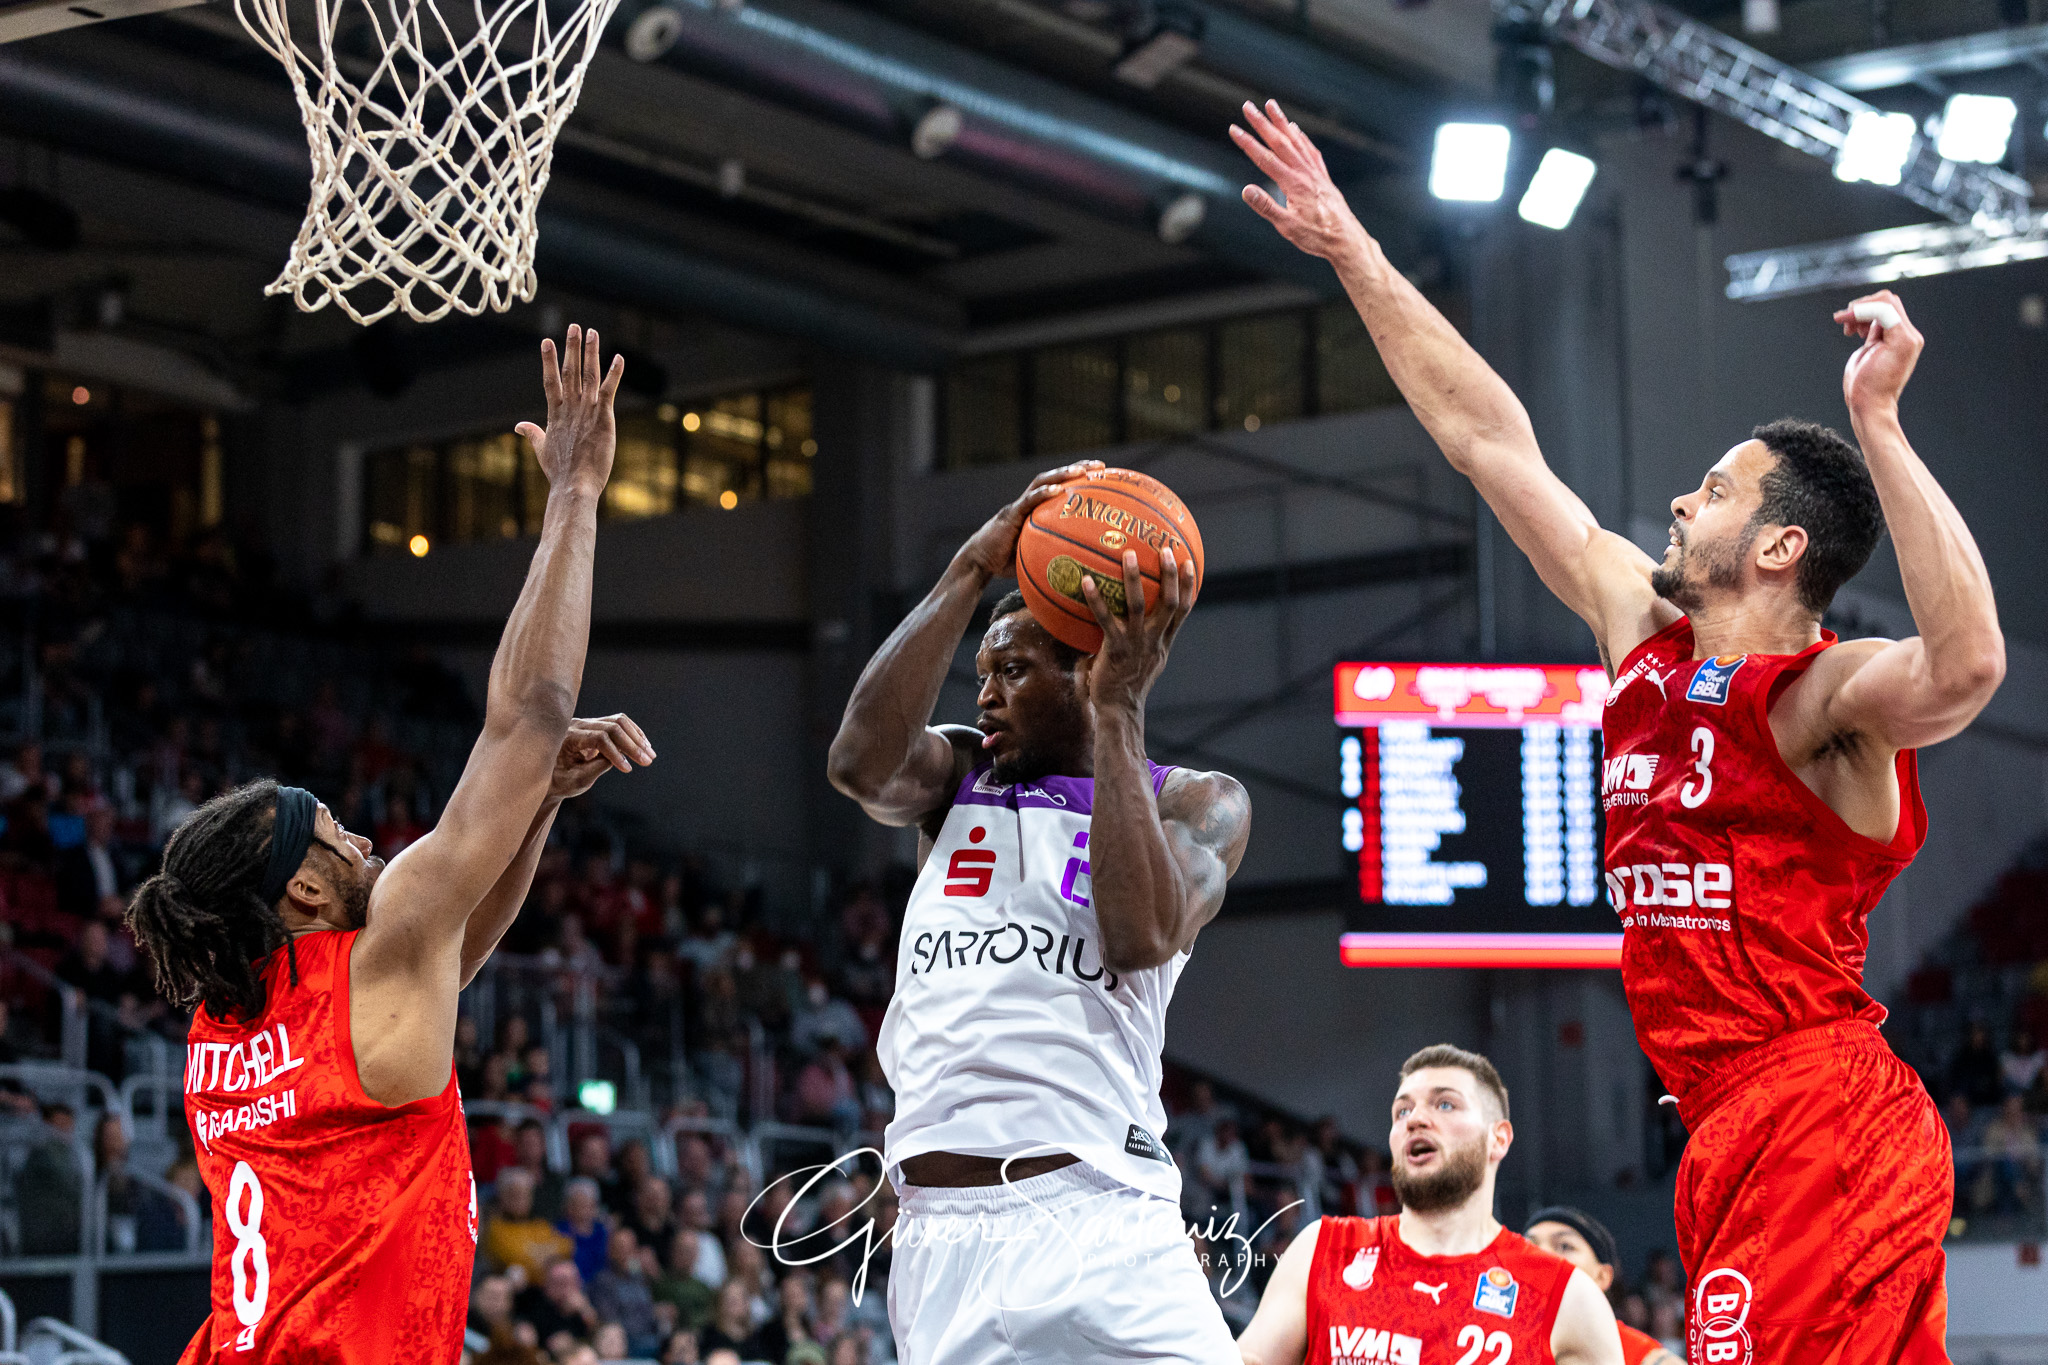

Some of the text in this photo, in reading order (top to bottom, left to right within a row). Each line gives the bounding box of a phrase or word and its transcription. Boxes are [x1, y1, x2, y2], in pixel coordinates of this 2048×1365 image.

[1060, 494, 1180, 552] SPALDING
[1691, 680, 1721, 698] BBL
[1680, 727, 1715, 809] 3
[911, 922, 1119, 992] SARTORIUS
[185, 1023, 305, 1094] MITCHELL
[226, 1160, 270, 1326] 8
[1455, 1324, 1512, 1365] 22
